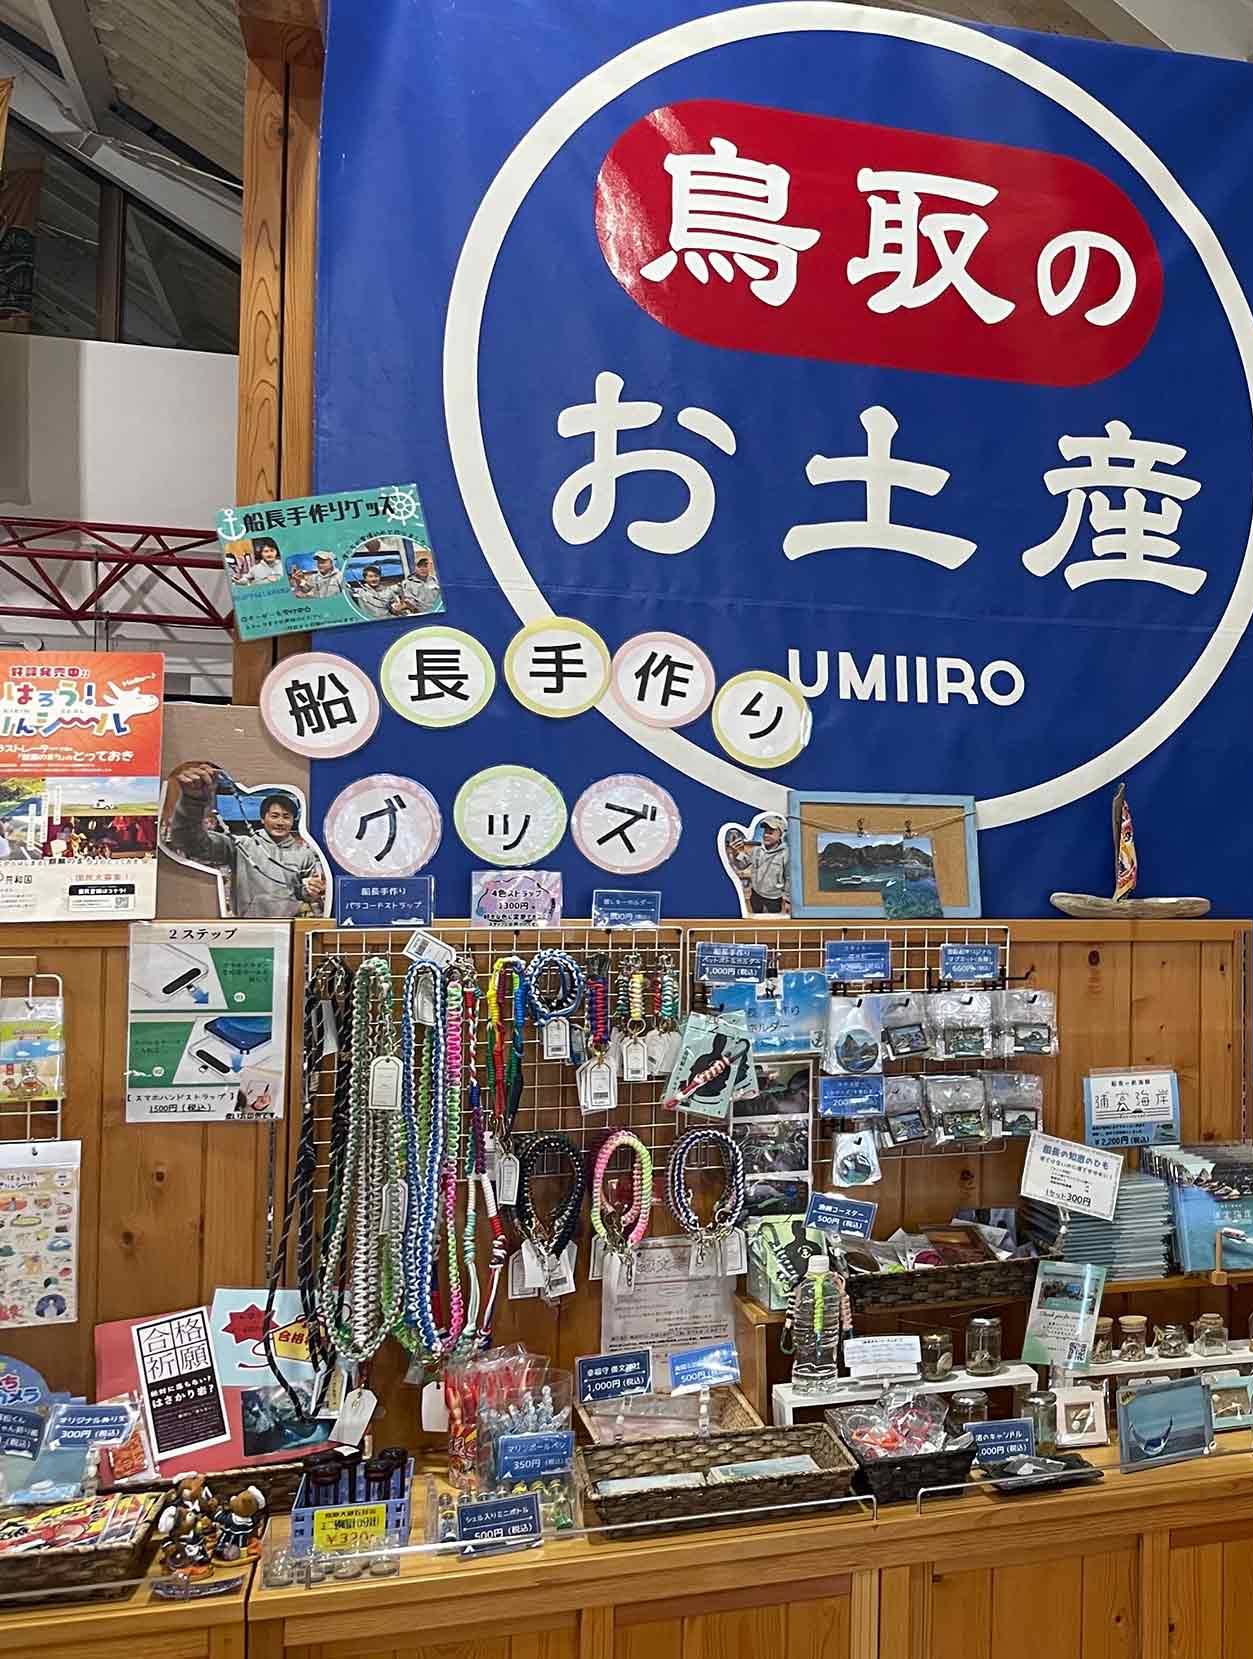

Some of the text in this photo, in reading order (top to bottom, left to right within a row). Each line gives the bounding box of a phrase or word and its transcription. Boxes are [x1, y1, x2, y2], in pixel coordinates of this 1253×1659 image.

[639, 136, 1137, 327] 鳥取の
[551, 370, 1207, 596] お土産
[787, 649, 1026, 707] UMIIRO
[142, 1317, 205, 1352] 合格
